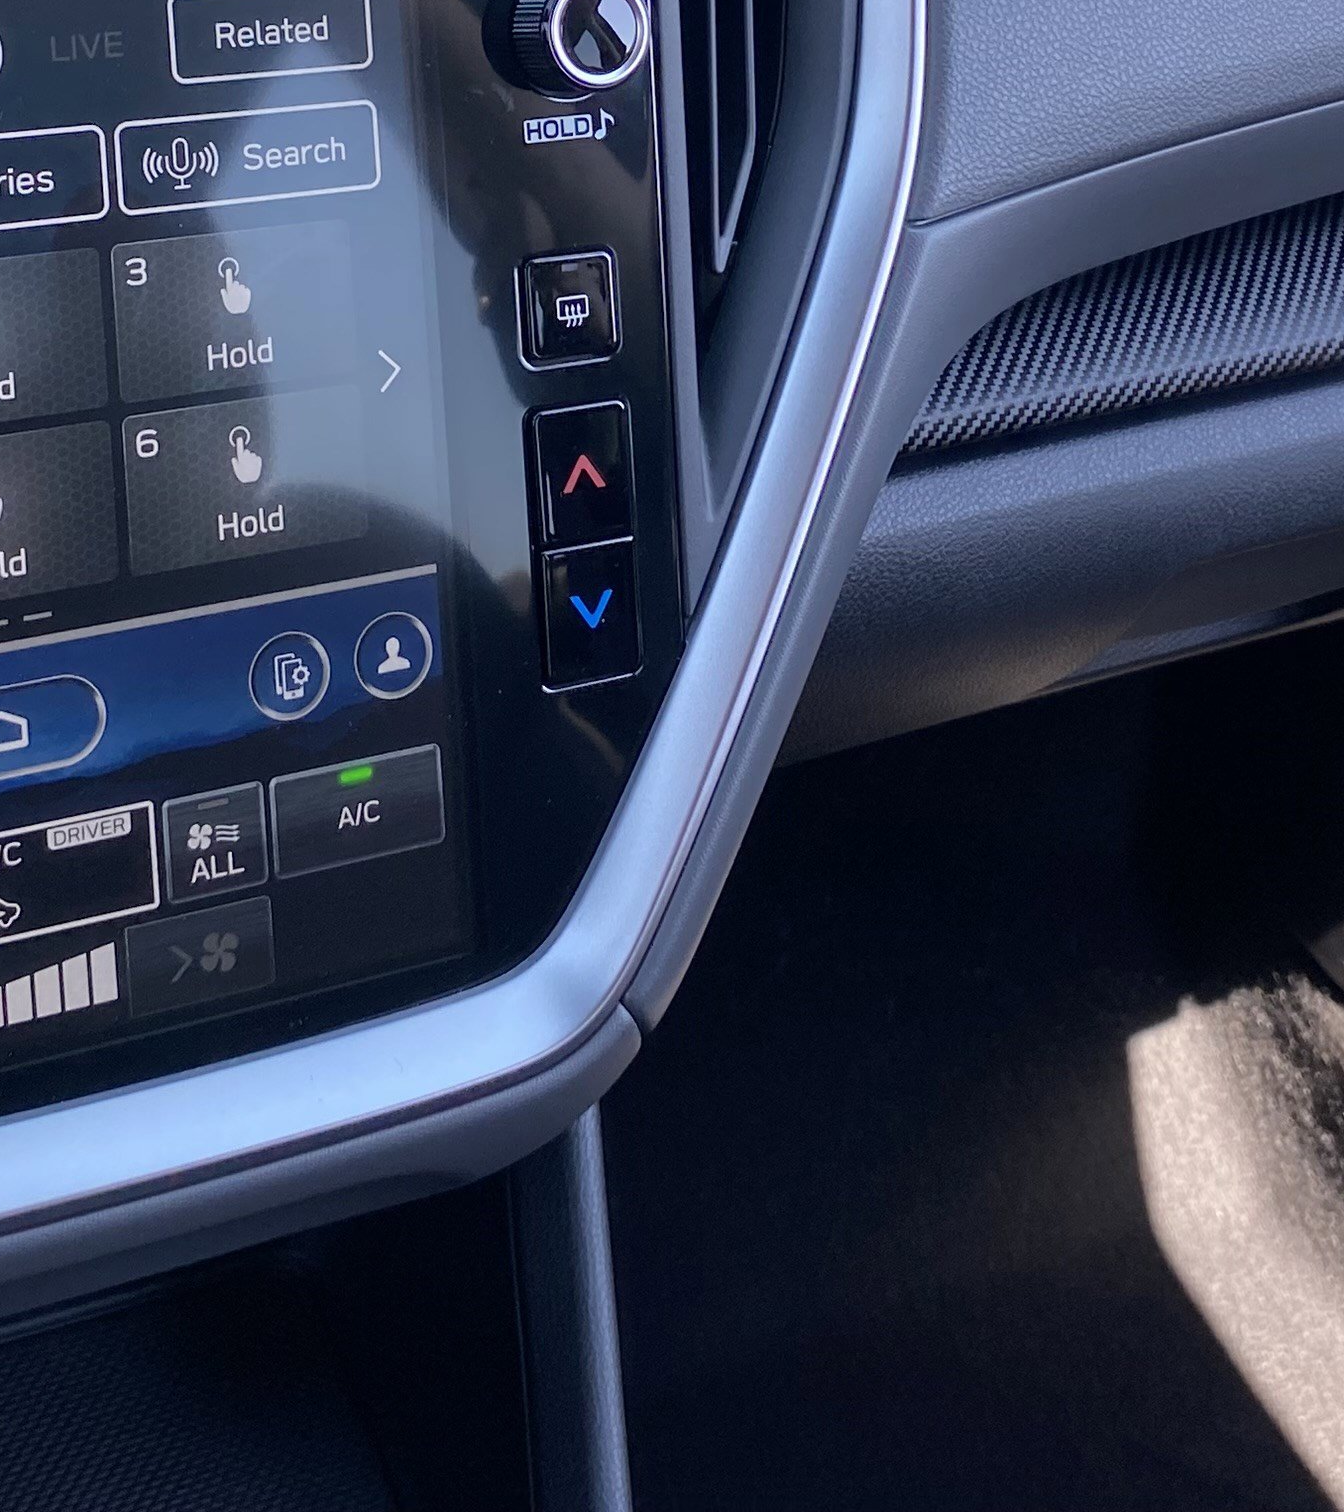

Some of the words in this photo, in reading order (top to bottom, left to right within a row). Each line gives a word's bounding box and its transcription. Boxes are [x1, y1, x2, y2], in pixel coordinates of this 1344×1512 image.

[49, 29, 125, 64] LIVE
[215, 14, 329, 49] Related
[243, 136, 346, 171] Search
[125, 257, 148, 286] 3
[207, 335, 274, 371] Hold
[135, 428, 159, 458] 6
[217, 504, 284, 541] Hold
[49, 813, 130, 848] DRIVER
[338, 799, 381, 830] A/C
[190, 852, 246, 884] ALL
